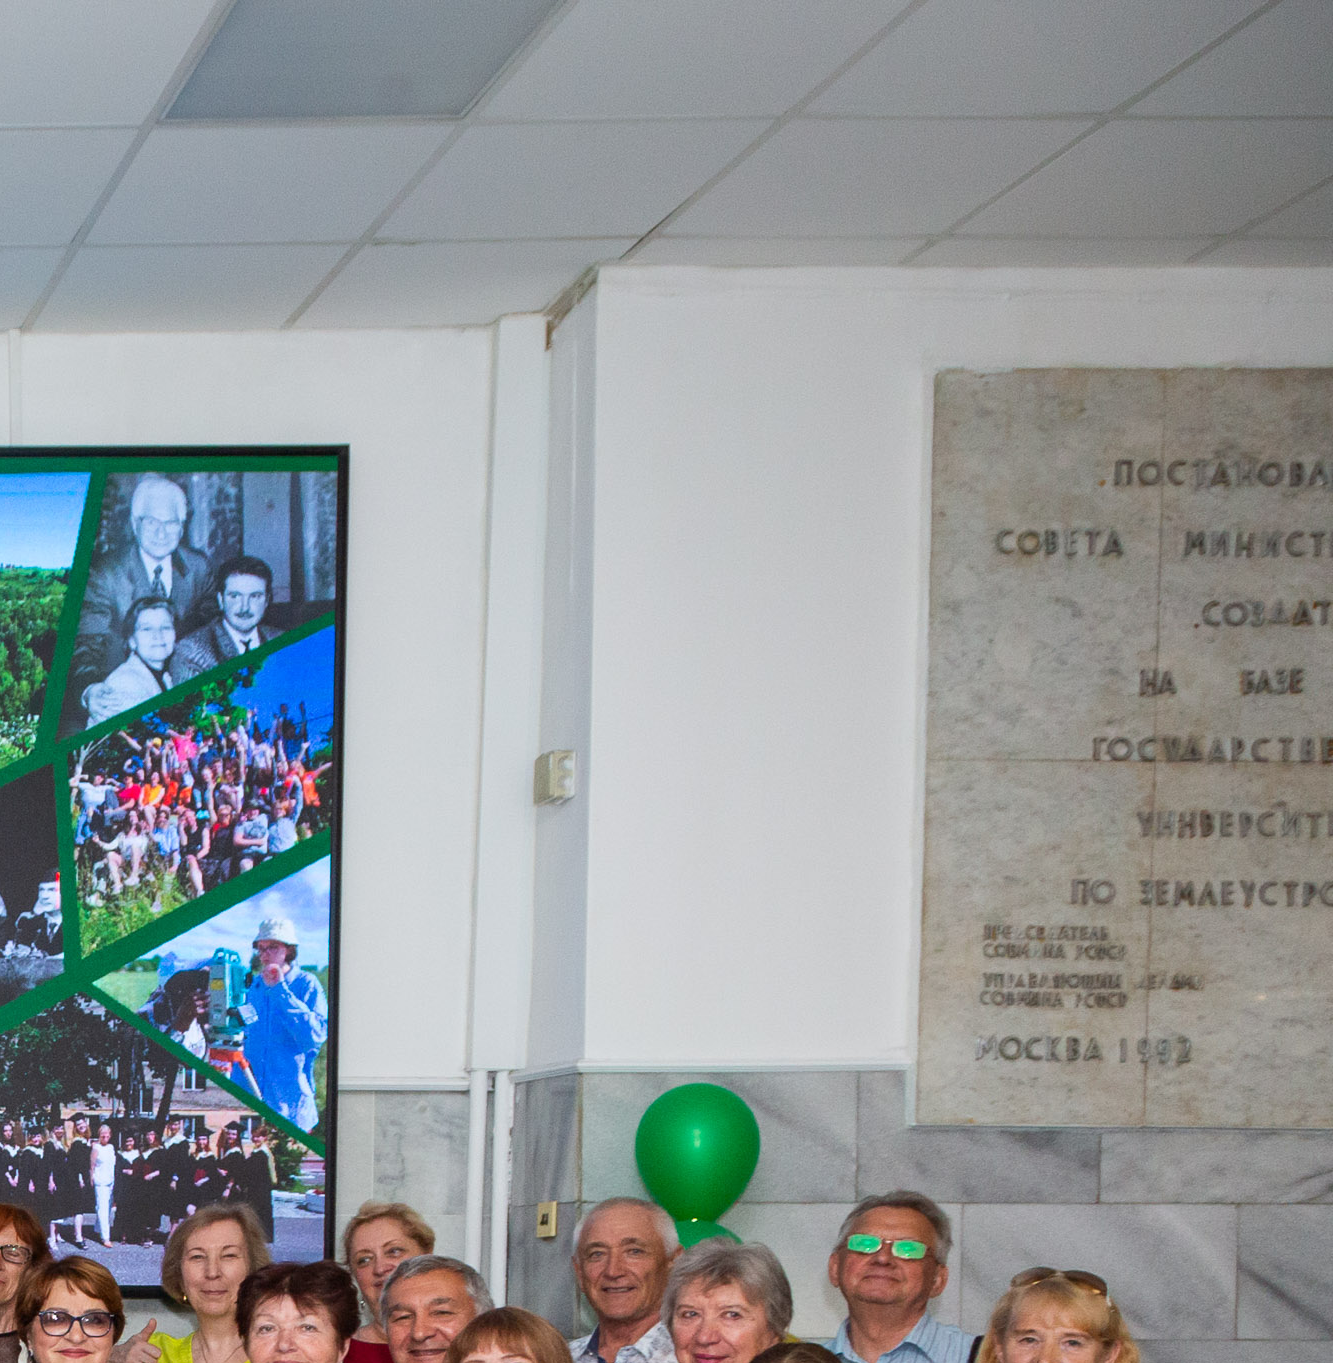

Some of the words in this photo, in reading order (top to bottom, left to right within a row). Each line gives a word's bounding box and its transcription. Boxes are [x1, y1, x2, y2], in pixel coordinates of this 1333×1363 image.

[1113, 459, 1333, 488] ПОСТАНОВЛ
[995, 529, 1124, 558] СОВЕТА
[1184, 529, 1333, 559] МИНИСТ
[1139, 668, 1177, 696] НА
[1240, 668, 1305, 696] БАЗЕ
[1070, 878, 1116, 905] ПО
[983, 924, 1109, 941] ПРЕСЕАТЕЛЬ
[974, 1034, 1104, 1062] МОСКВА
